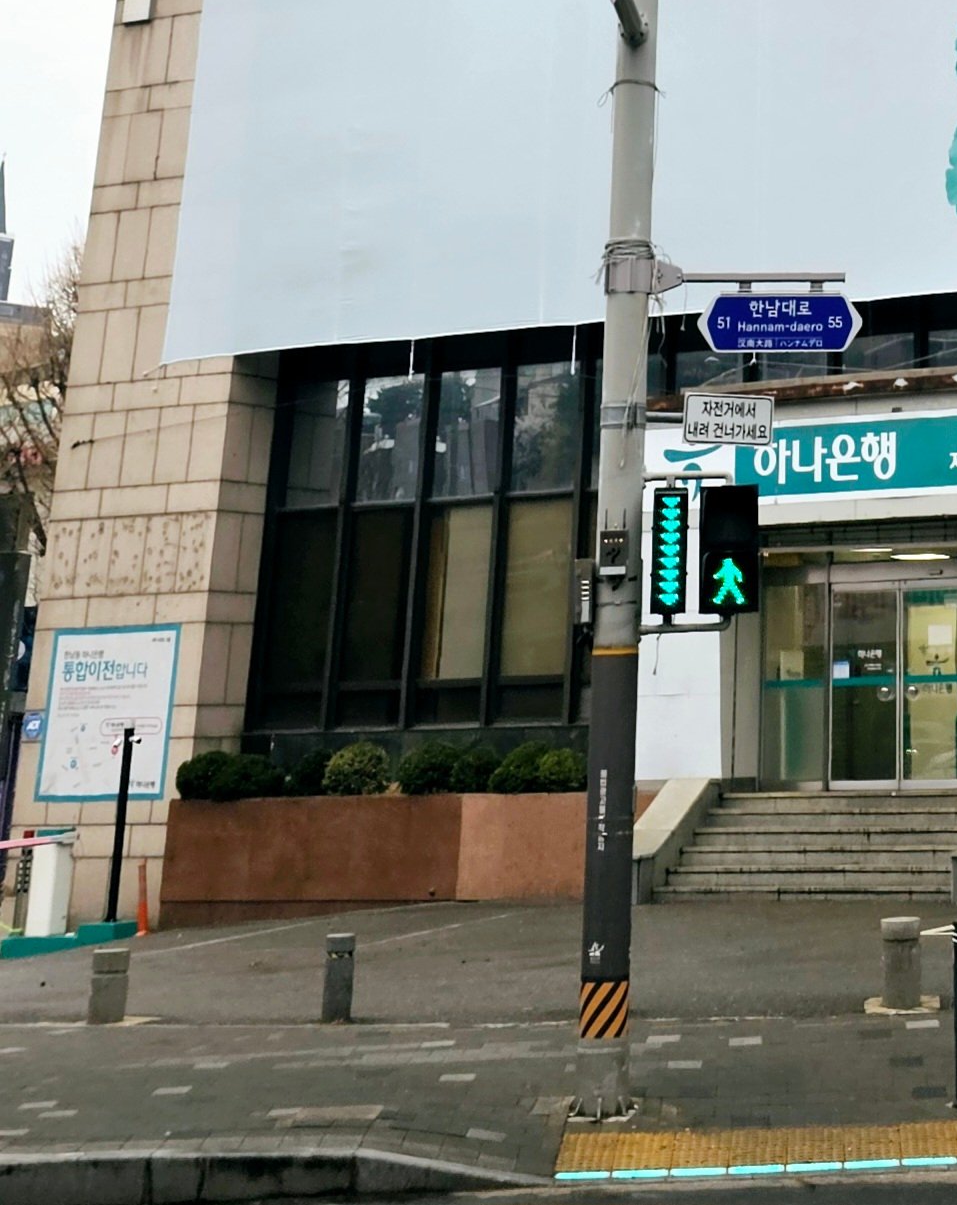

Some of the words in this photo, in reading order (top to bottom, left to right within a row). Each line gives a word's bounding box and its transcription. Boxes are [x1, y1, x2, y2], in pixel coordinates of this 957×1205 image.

[748, 299, 813, 318] 한남대로
[716, 316, 731, 329] 51
[738, 320, 823, 333] Hannam-daero
[827, 315, 843, 329] 55
[702, 399, 757, 419] 자전거에서
[687, 421, 710, 439] 내려
[712, 422, 768, 440] 건너가세요
[753, 431, 897, 484] 하나은행
[62, 660, 148, 683] 통합이전합니다
